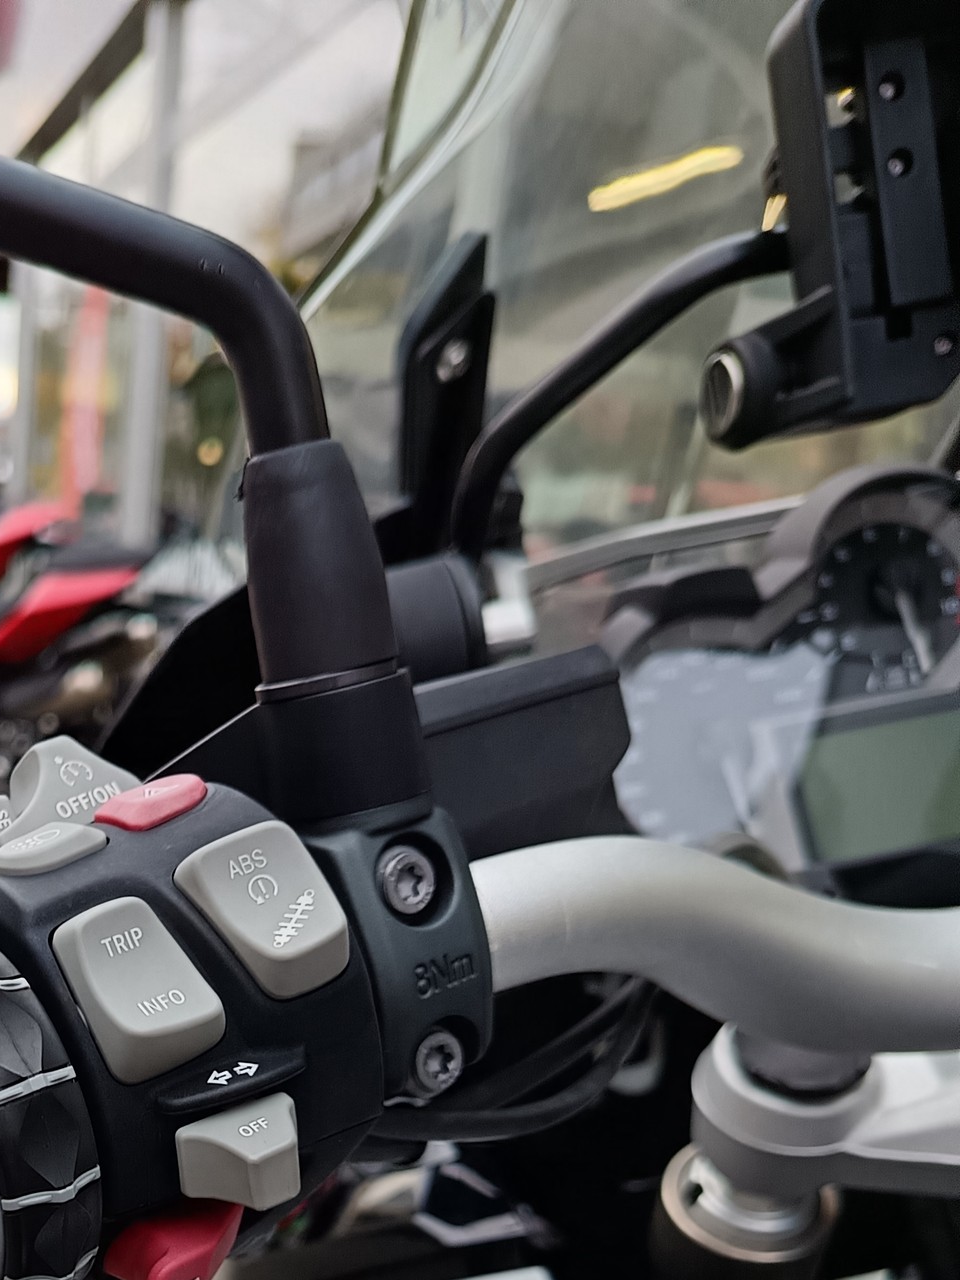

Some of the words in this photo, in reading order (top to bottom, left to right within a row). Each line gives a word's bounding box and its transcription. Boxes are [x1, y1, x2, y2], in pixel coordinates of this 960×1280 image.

[55, 781, 122, 819] OFF/ON
[229, 848, 268, 880] ABS
[100, 927, 143, 957] TRIP
[136, 989, 186, 1018] INFO
[238, 1117, 269, 1137] OFF
